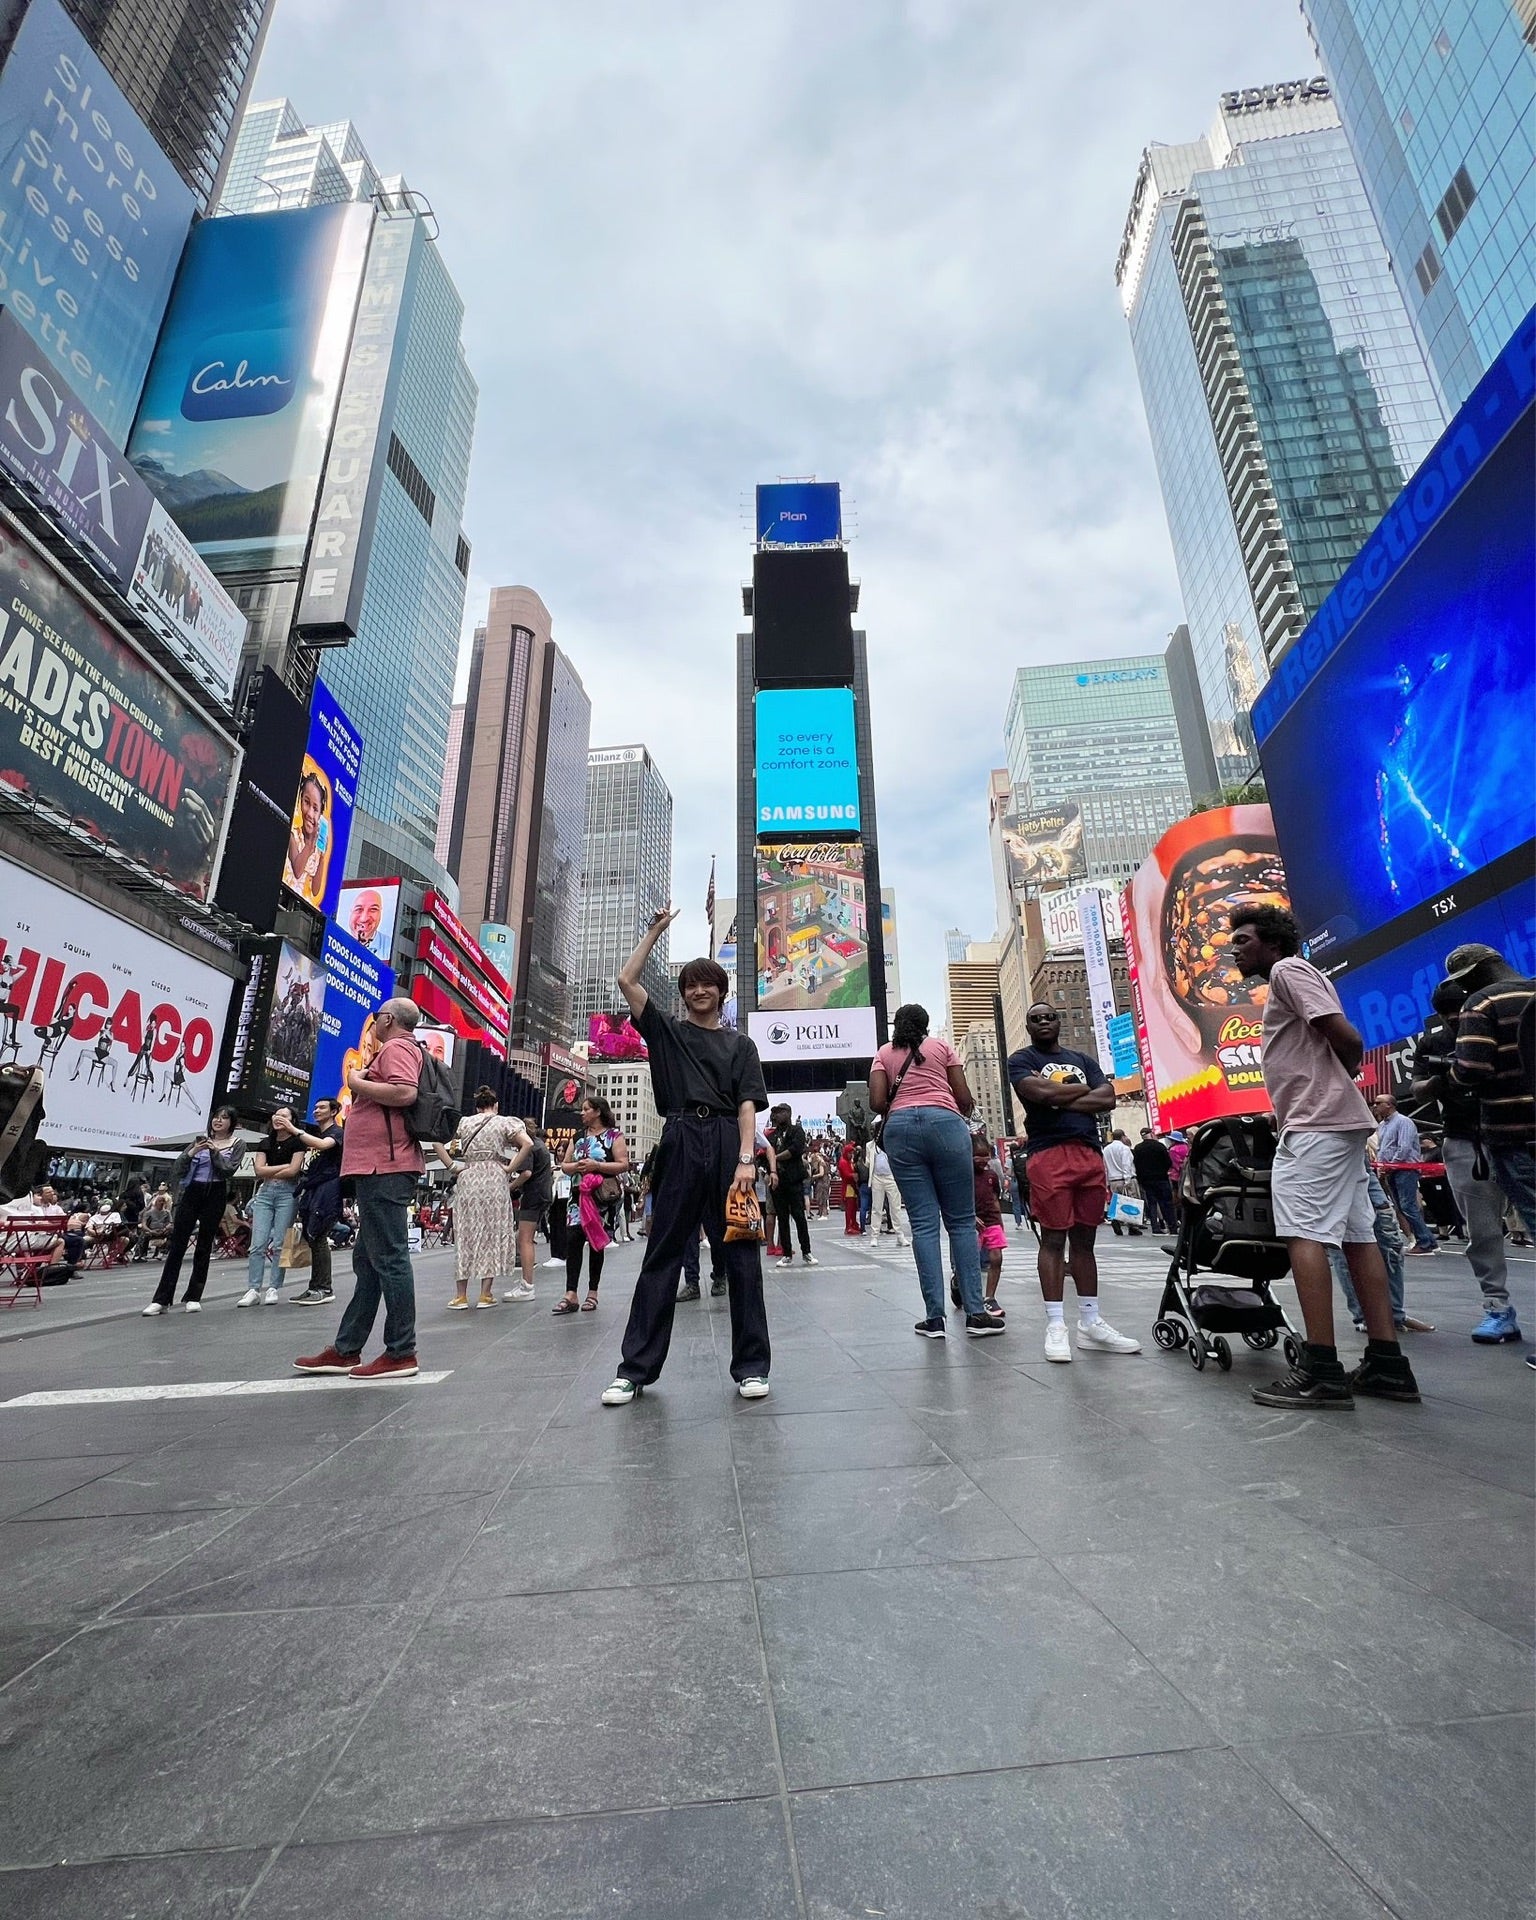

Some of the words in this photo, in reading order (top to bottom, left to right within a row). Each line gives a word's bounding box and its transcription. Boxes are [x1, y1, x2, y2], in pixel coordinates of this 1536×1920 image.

[54, 54, 157, 200] Sleep
[44, 88, 148, 236] more.
[12, 157, 98, 280] less.
[24, 129, 140, 282] Stress
[352, 228, 401, 367] TIMES
[191, 360, 290, 394] Calm
[6, 367, 129, 546] SIX
[32, 459, 53, 487] THE
[54, 486, 96, 536] MUSICAL
[309, 391, 377, 597] SQUARE
[779, 511, 808, 522] Plan
[1274, 421, 1484, 702] Reflection
[199, 618, 236, 671] WRONG
[11, 597, 44, 633] COME
[43, 624, 64, 648] SEE
[61, 639, 85, 669] HOW
[84, 661, 102, 686] THE
[101, 676, 131, 709] WORLD
[129, 702, 154, 732] COULD
[152, 723, 165, 743] BE.
[1091, 668, 1159, 686] BARCLAYS
[0, 607, 185, 812] ADESTOWN
[68, 740, 91, 766] AND
[318, 710, 345, 748] HEALTHY
[342, 744, 359, 769] FOOD
[327, 737, 348, 767] EVERY
[345, 761, 358, 780] DAY
[333, 716, 352, 744] EVERY
[351, 740, 361, 758] KID
[588, 753, 621, 763] Allianz
[778, 734, 793, 743] so
[796, 733, 833, 743] every
[778, 747, 810, 756] zone
[813, 745, 823, 755] is
[826, 747, 835, 755] a
[19, 724, 65, 767] BEST
[62, 757, 126, 815] MUSICAL
[761, 758, 815, 771] comfort
[817, 758, 852, 770] zone.
[760, 804, 857, 821] SAMSUNG
[1017, 820, 1040, 836] Harry
[1040, 816, 1065, 831] Potter
[1432, 895, 1457, 917] TSX
[17, 921, 31, 933] SIX
[63, 941, 91, 958] SQUISH
[327, 935, 350, 960] TODOS
[349, 952, 362, 969] LOS
[361, 961, 379, 982] NIÑOS
[324, 953, 350, 979] COMIDA
[350, 970, 383, 1001] SALUDABLE
[326, 972, 345, 993] ODOS
[344, 985, 357, 1001] LOS
[356, 993, 371, 1010] DÍAS
[0, 937, 214, 1074] HICAGO
[322, 1011, 332, 1025] NO
[331, 1015, 342, 1029] KID
[796, 1024, 840, 1041] PGIM
[1140, 1038, 1151, 1070] FREE
